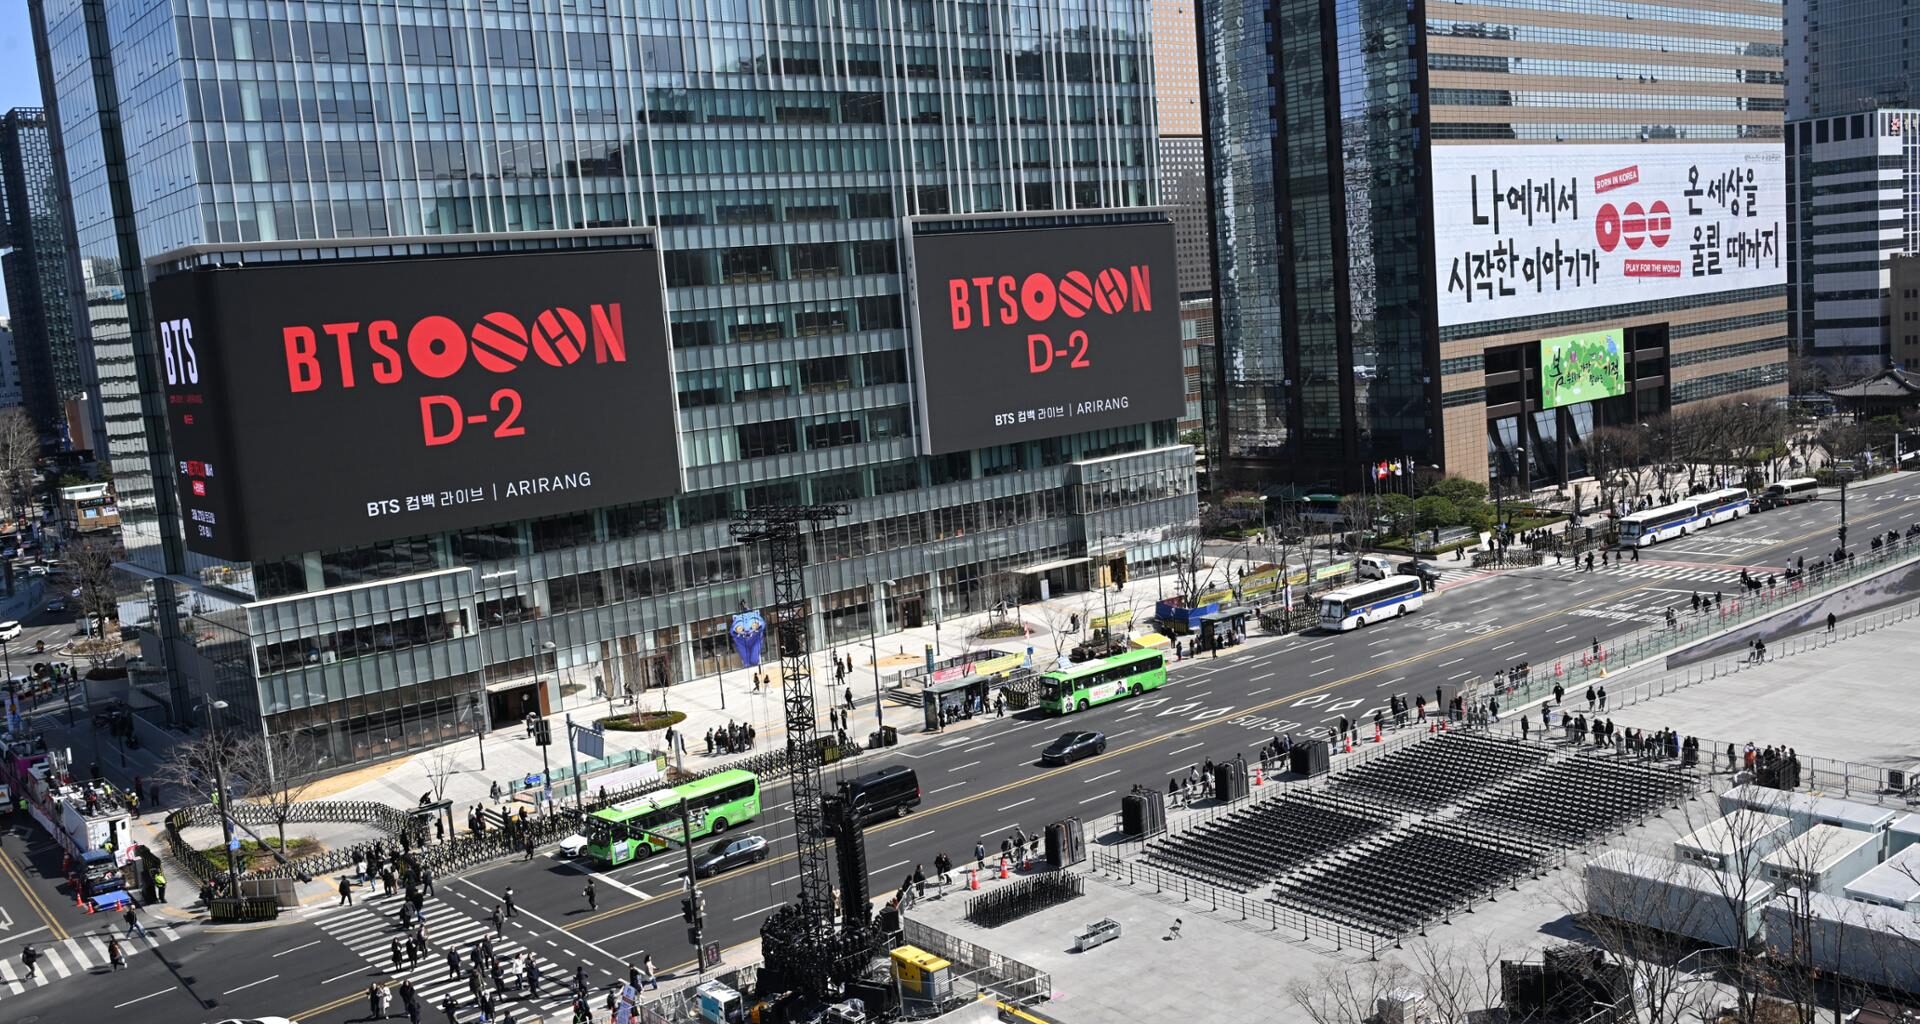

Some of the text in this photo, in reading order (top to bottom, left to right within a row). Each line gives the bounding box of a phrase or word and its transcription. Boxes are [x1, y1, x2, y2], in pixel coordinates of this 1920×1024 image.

[1471, 169, 1578, 235] 나에게서
[1596, 178, 1612, 189] BORN
[1619, 171, 1637, 183] KOREA
[1684, 165, 1758, 217] 온 세상을
[1447, 238, 1600, 303] 시작한 이야기가
[1625, 263, 1680, 273] PLAY FOR THE WORLD
[1689, 221, 1779, 276] 울릴 때까지
[161, 318, 198, 385] BTS
[1027, 329, 1090, 374] D-2
[420, 388, 526, 448] D-2
[994, 396, 1129, 426] BTS 컴백 라이브 ARIRANG
[366, 471, 592, 517] BTS 컴백 라이브 ARIRANG
[1227, 715, 1267, 726] 50
[1261, 720, 1302, 732] 50
